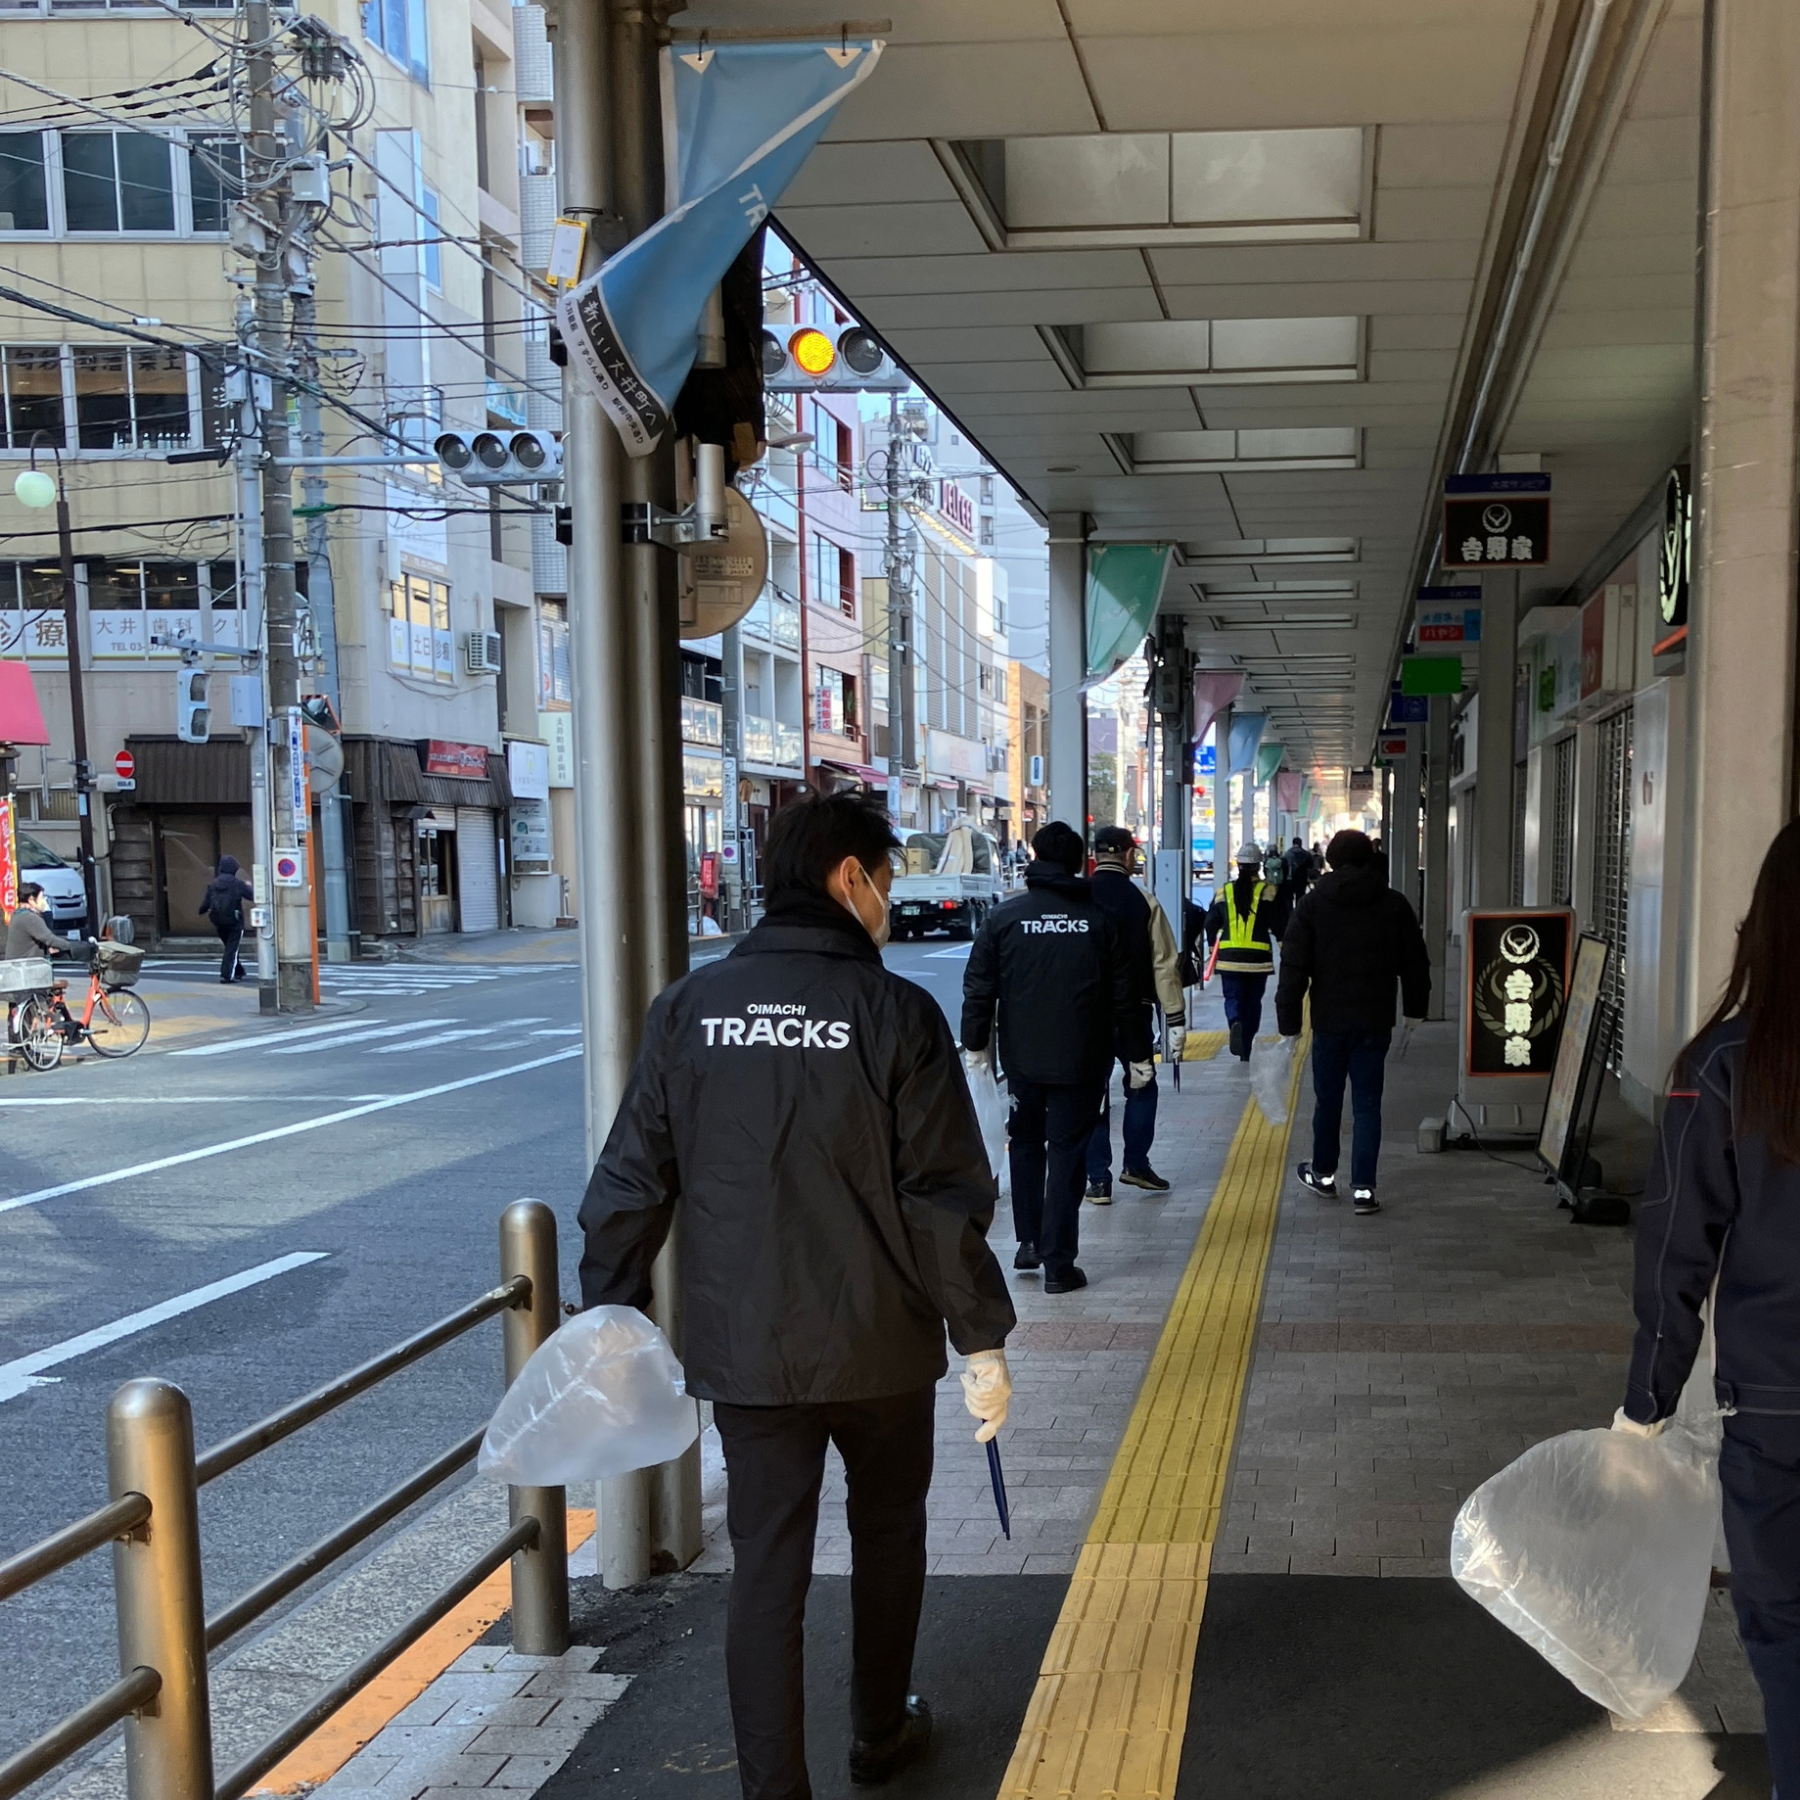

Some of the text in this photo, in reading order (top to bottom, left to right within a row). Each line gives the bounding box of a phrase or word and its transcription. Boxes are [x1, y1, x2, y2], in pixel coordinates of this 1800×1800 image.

[1021, 920, 1089, 934] TRACKS
[747, 1003, 806, 1016] OIMACHI
[701, 1018, 851, 1049] TRACKS
